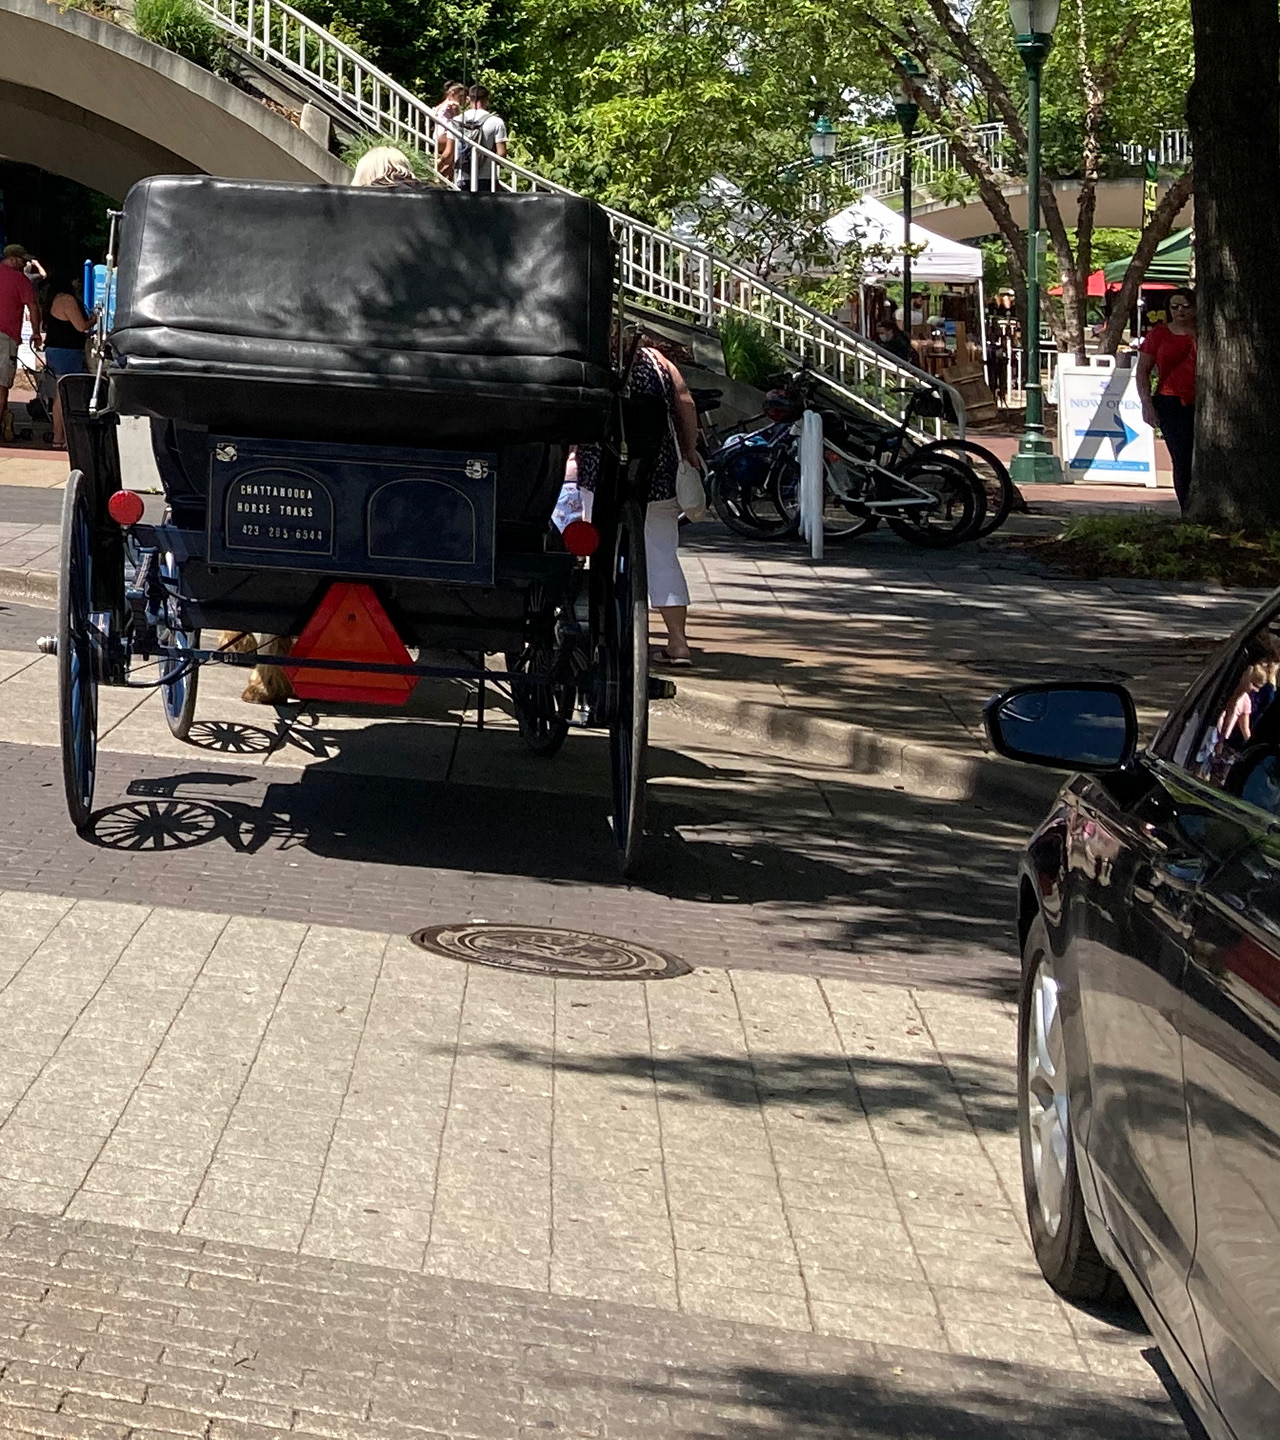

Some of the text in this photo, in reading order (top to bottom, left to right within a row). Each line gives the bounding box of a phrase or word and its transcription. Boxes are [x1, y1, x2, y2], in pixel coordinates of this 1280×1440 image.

[1070, 398, 1141, 410] NOW OPEN
[237, 502, 271, 514] HORSE
[242, 524, 259, 535] 423
